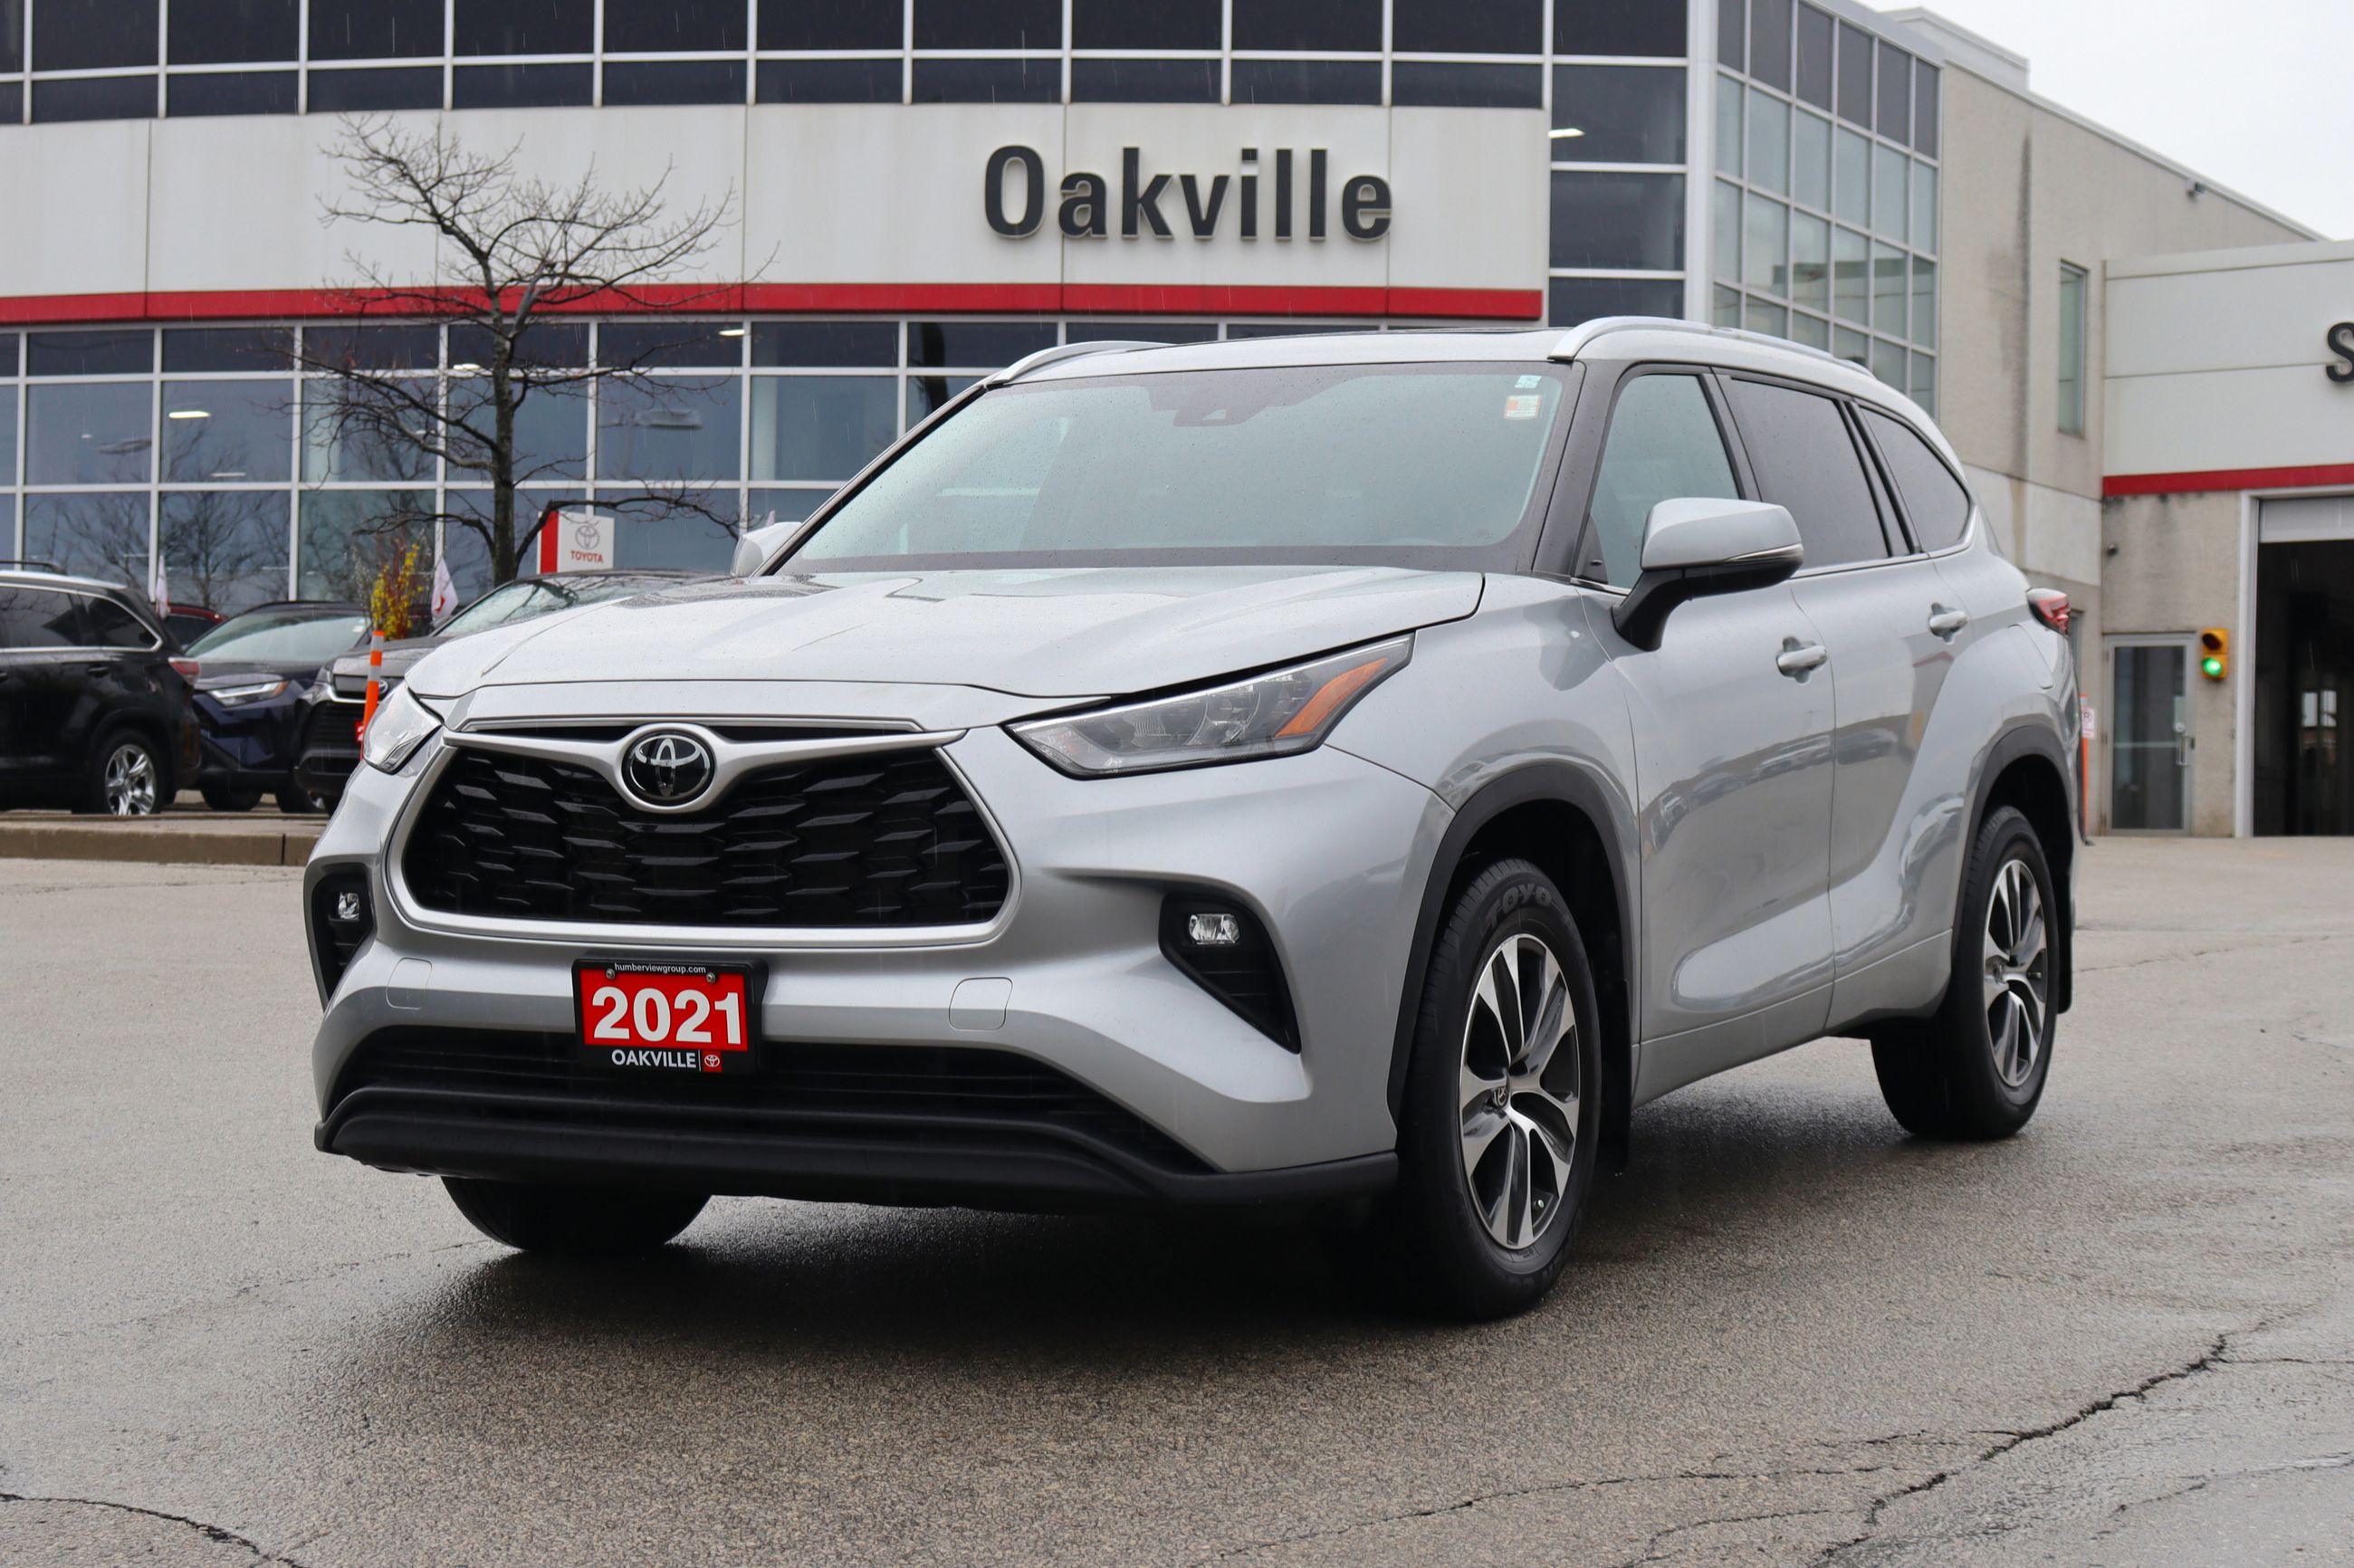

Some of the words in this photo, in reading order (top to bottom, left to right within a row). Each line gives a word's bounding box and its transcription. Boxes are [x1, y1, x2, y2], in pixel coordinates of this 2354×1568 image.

[985, 144, 1392, 242] Oakville
[570, 550, 604, 563] TOYOTA
[1485, 884, 1552, 930] TOYO
[614, 962, 706, 974] humberviewgroup.com
[592, 986, 742, 1045] 2021
[611, 1049, 697, 1068] OAKVILLE
